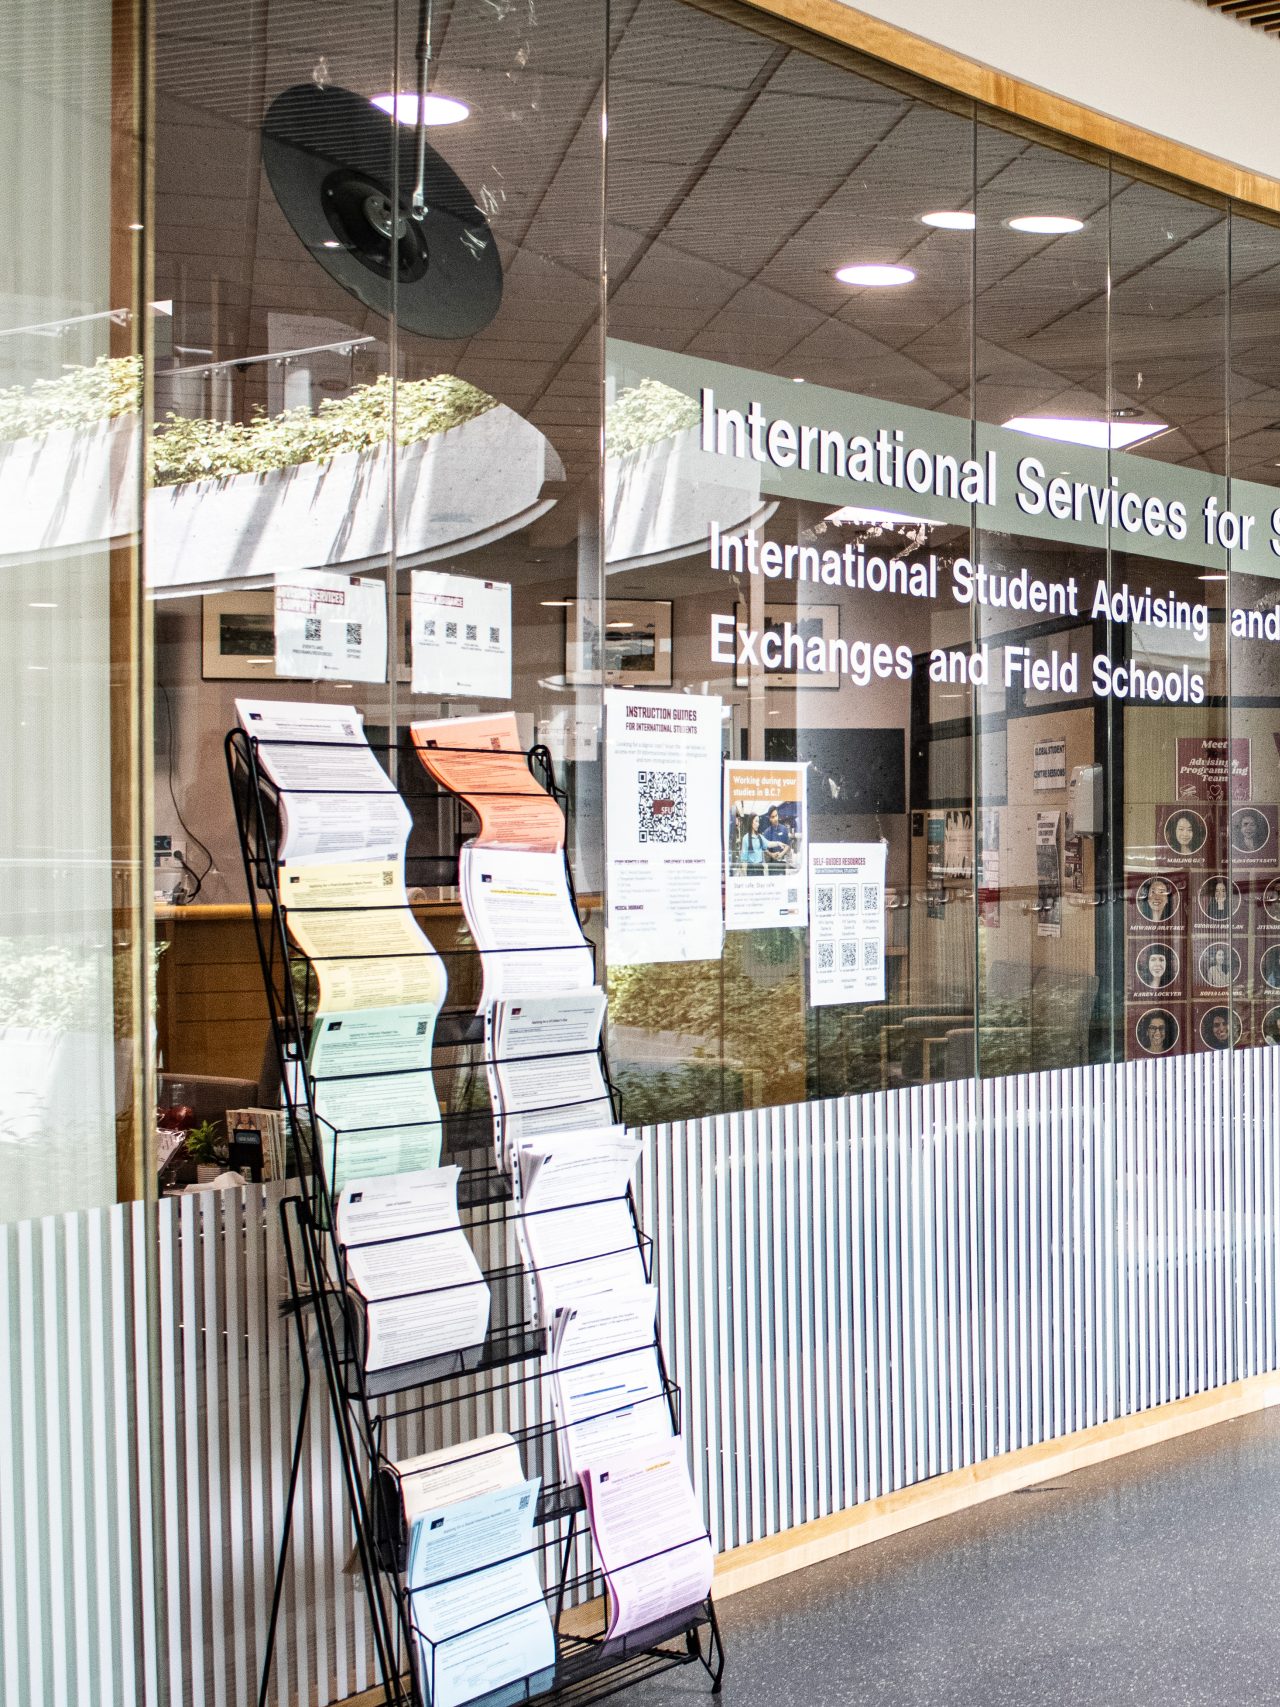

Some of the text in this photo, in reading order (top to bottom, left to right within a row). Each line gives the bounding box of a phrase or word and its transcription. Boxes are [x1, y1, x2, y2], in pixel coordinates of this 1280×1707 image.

[701, 388, 997, 506] International
[1017, 456, 1188, 540] Services
[1203, 496, 1255, 551] for
[710, 521, 938, 598] International
[952, 557, 1078, 616] Student
[1091, 580, 1209, 642] Advising
[1231, 604, 1280, 641] and
[710, 613, 1205, 703] Exchanges and Field Schools
[626, 705, 697, 721] INSTRUCTION GUIDES
[626, 722, 698, 734] FOR INTERNATIONAL STUDENTS
[1048, 745, 1064, 754] STUDENT
[1201, 740, 1228, 749] Meet
[1189, 758, 1229, 768] Advising
[733, 775, 797, 788] Working during your
[733, 788, 756, 797] studies
[813, 857, 866, 866] SELF-GUIDED RESOURCES
